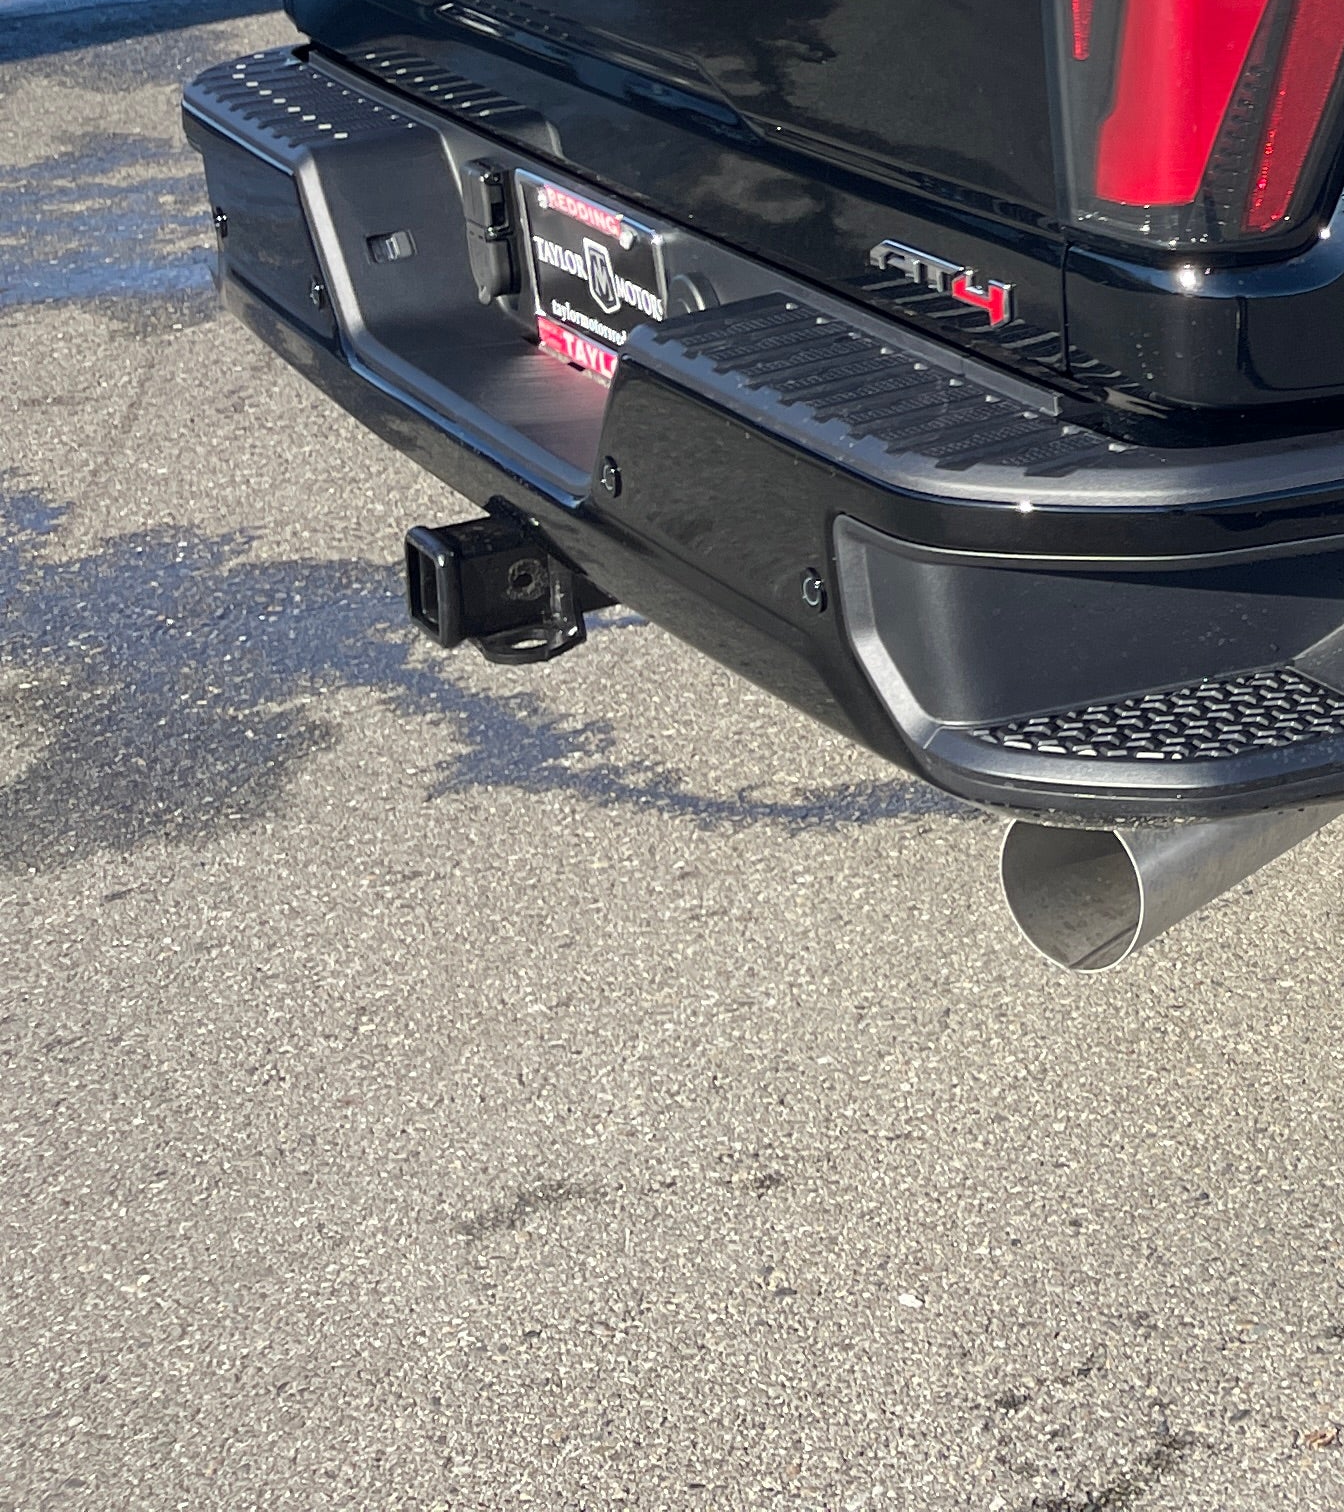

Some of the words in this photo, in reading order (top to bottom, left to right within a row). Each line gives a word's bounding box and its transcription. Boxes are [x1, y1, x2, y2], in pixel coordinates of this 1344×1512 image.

[547, 187, 619, 236] REDDING
[532, 235, 590, 281] TAYLOR
[614, 274, 664, 322] MOTORS
[869, 239, 1018, 328] AT4
